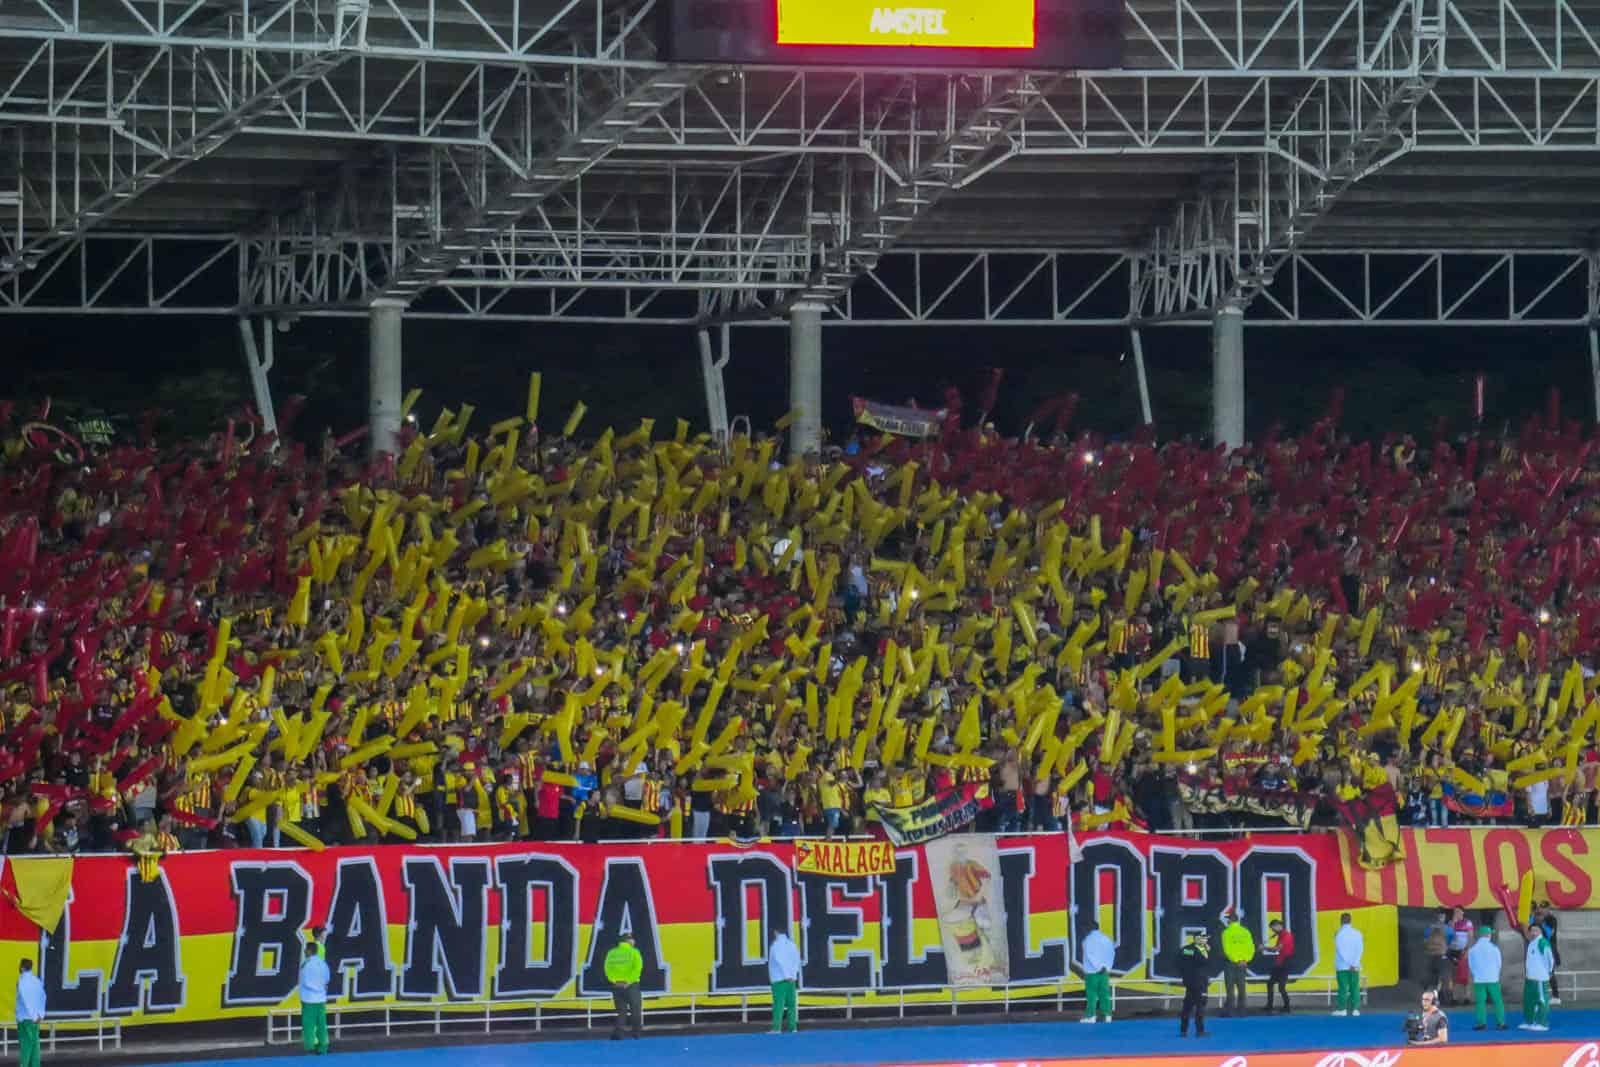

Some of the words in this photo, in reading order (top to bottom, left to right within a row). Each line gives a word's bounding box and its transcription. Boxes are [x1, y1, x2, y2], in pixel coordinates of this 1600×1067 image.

[870, 8, 948, 34] AMSTEL
[814, 842, 893, 874] MALAGA
[39, 865, 187, 1020] LA
[222, 852, 670, 1007] BANDA
[708, 849, 949, 995] DEL
[998, 837, 1319, 984] LOBO
